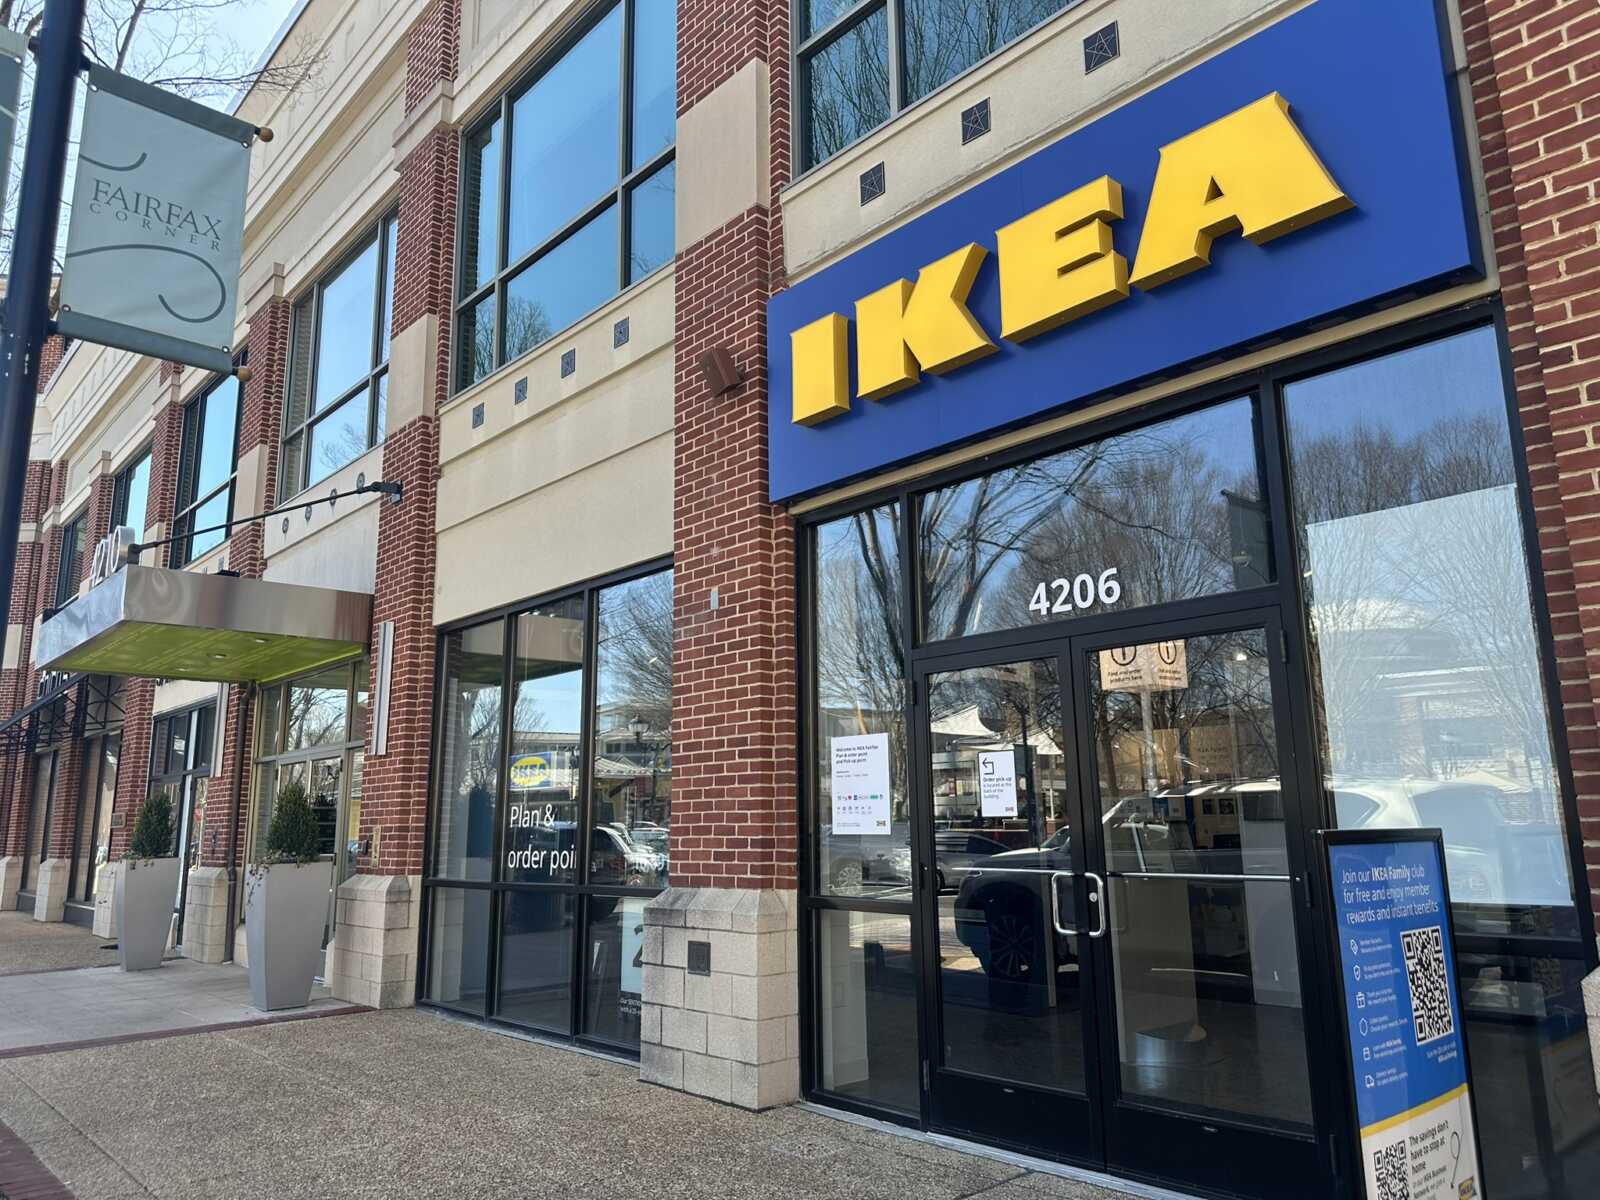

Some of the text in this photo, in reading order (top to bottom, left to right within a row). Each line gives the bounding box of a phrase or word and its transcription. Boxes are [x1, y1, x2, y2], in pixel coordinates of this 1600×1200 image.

[92, 178, 222, 241] FAIRFAX
[89, 202, 220, 252] CORNER
[790, 91, 1357, 428] IKEA
[1028, 567, 1121, 616] 4206
[510, 803, 555, 829] Plan &
[507, 844, 547, 870] order
[1342, 869, 1357, 884] Join
[1358, 871, 1370, 882] our
[1371, 867, 1388, 881] IKEA
[1389, 864, 1411, 882] Family
[1343, 888, 1354, 904] for
[1356, 887, 1371, 902] free
[1372, 886, 1386, 900] and
[1405, 884, 1431, 898] member
[1346, 906, 1375, 924] rewards
[1376, 904, 1391, 920] and
[1409, 1135, 1419, 1146] The
